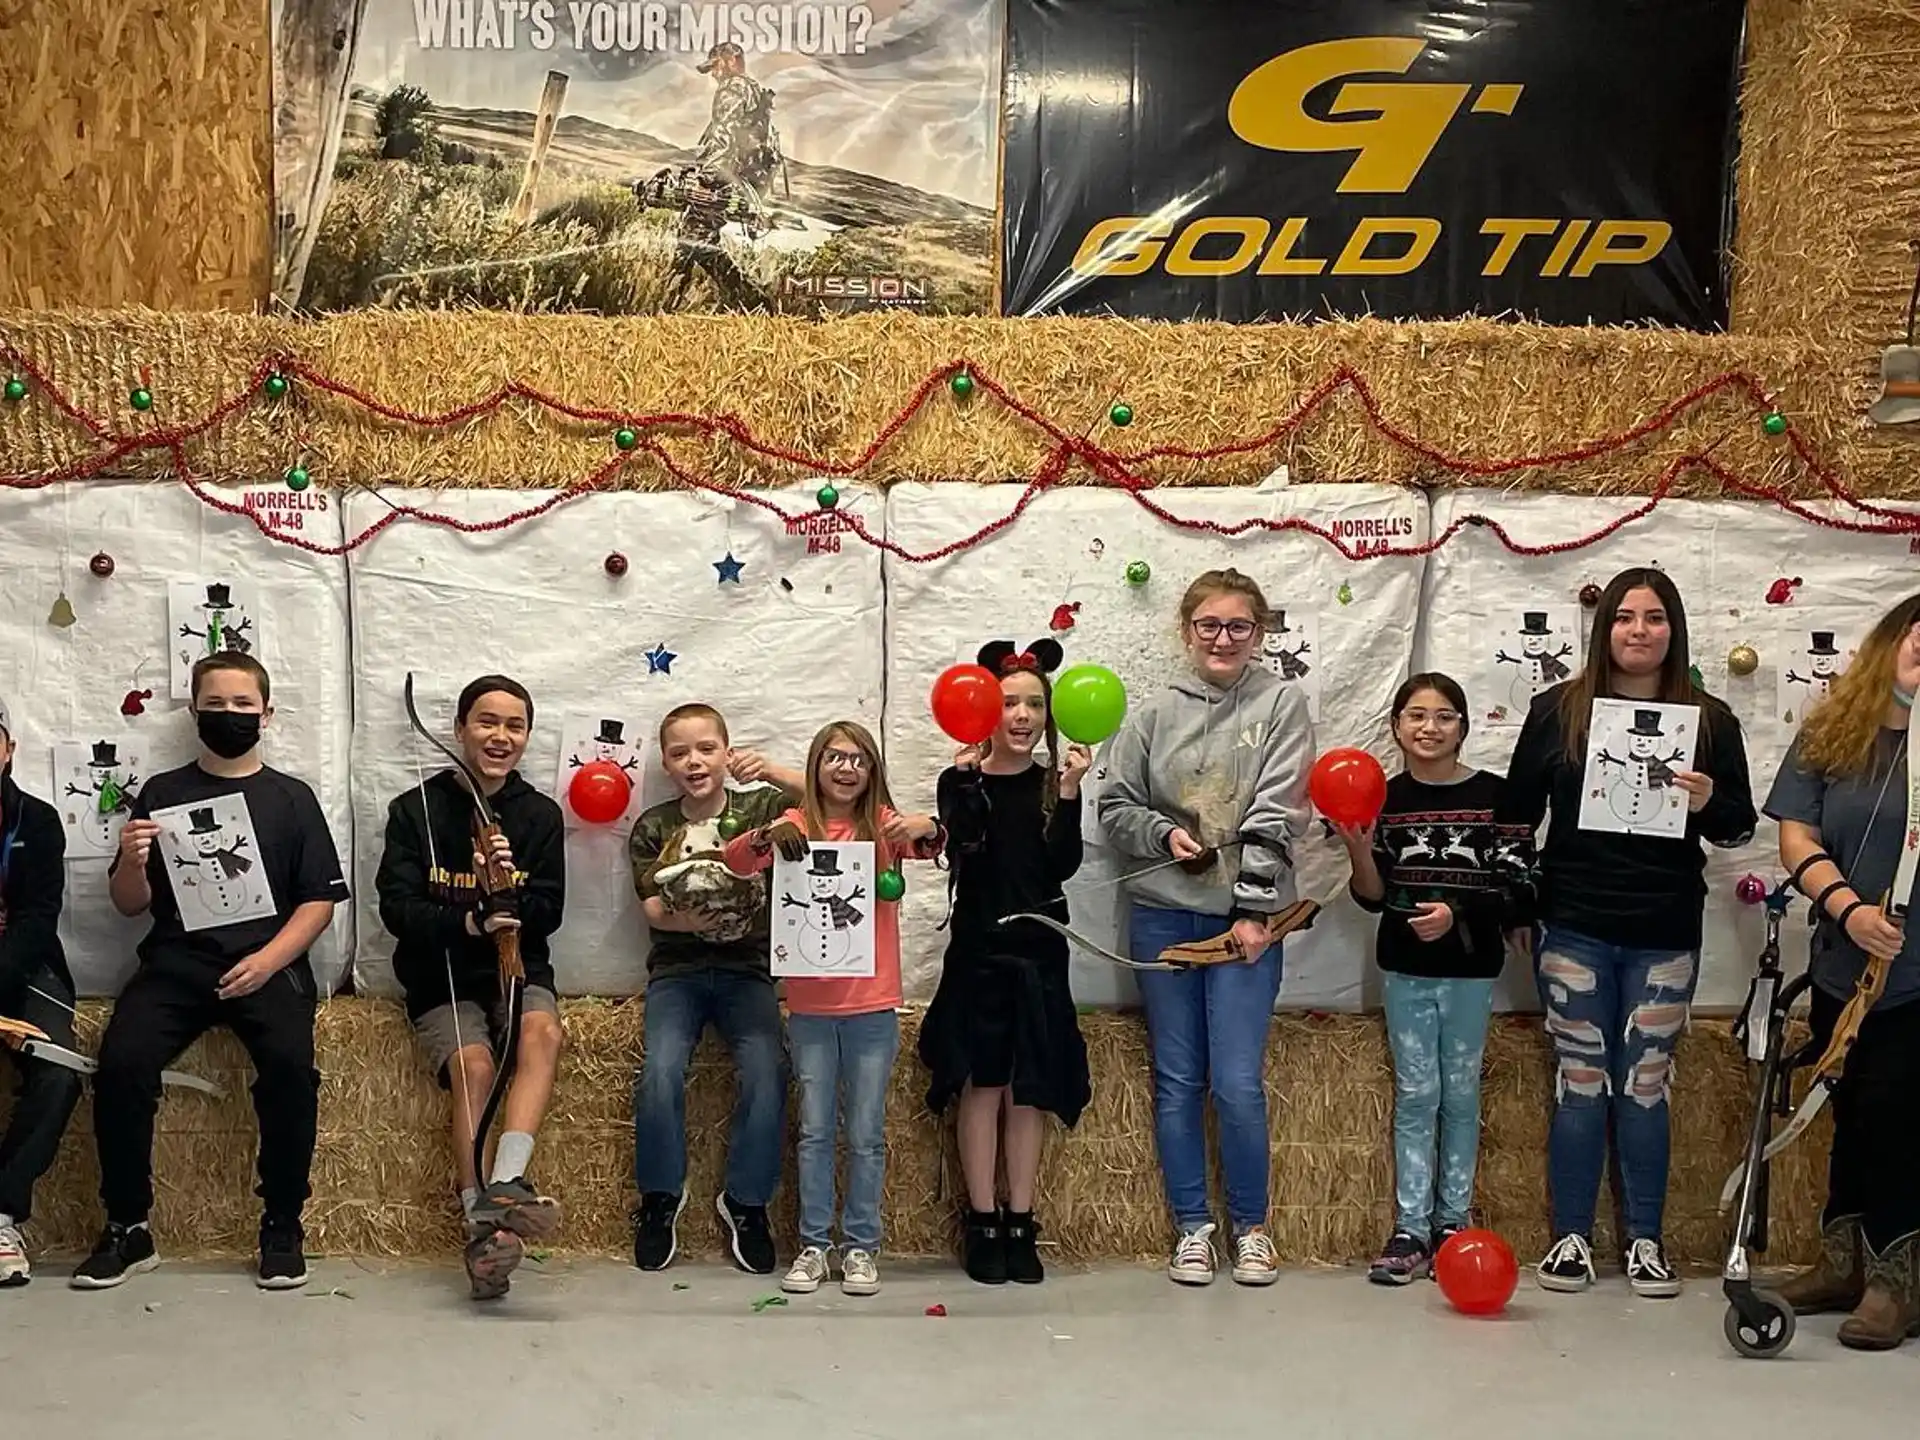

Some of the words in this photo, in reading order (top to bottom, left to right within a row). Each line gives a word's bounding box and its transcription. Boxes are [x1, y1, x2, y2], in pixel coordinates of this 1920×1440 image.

[414, 1, 556, 50] WHAT'S
[568, 1, 670, 53] YOUR
[679, 3, 874, 55] MISSION?
[1070, 216, 1443, 278] GOLD
[1477, 218, 1674, 279] TIP
[783, 275, 929, 298] MISSION
[243, 491, 328, 512] MORRELL'S
[268, 511, 304, 531] M-48
[1332, 517, 1413, 538] MORRELL'S
[807, 535, 842, 554] M-48
